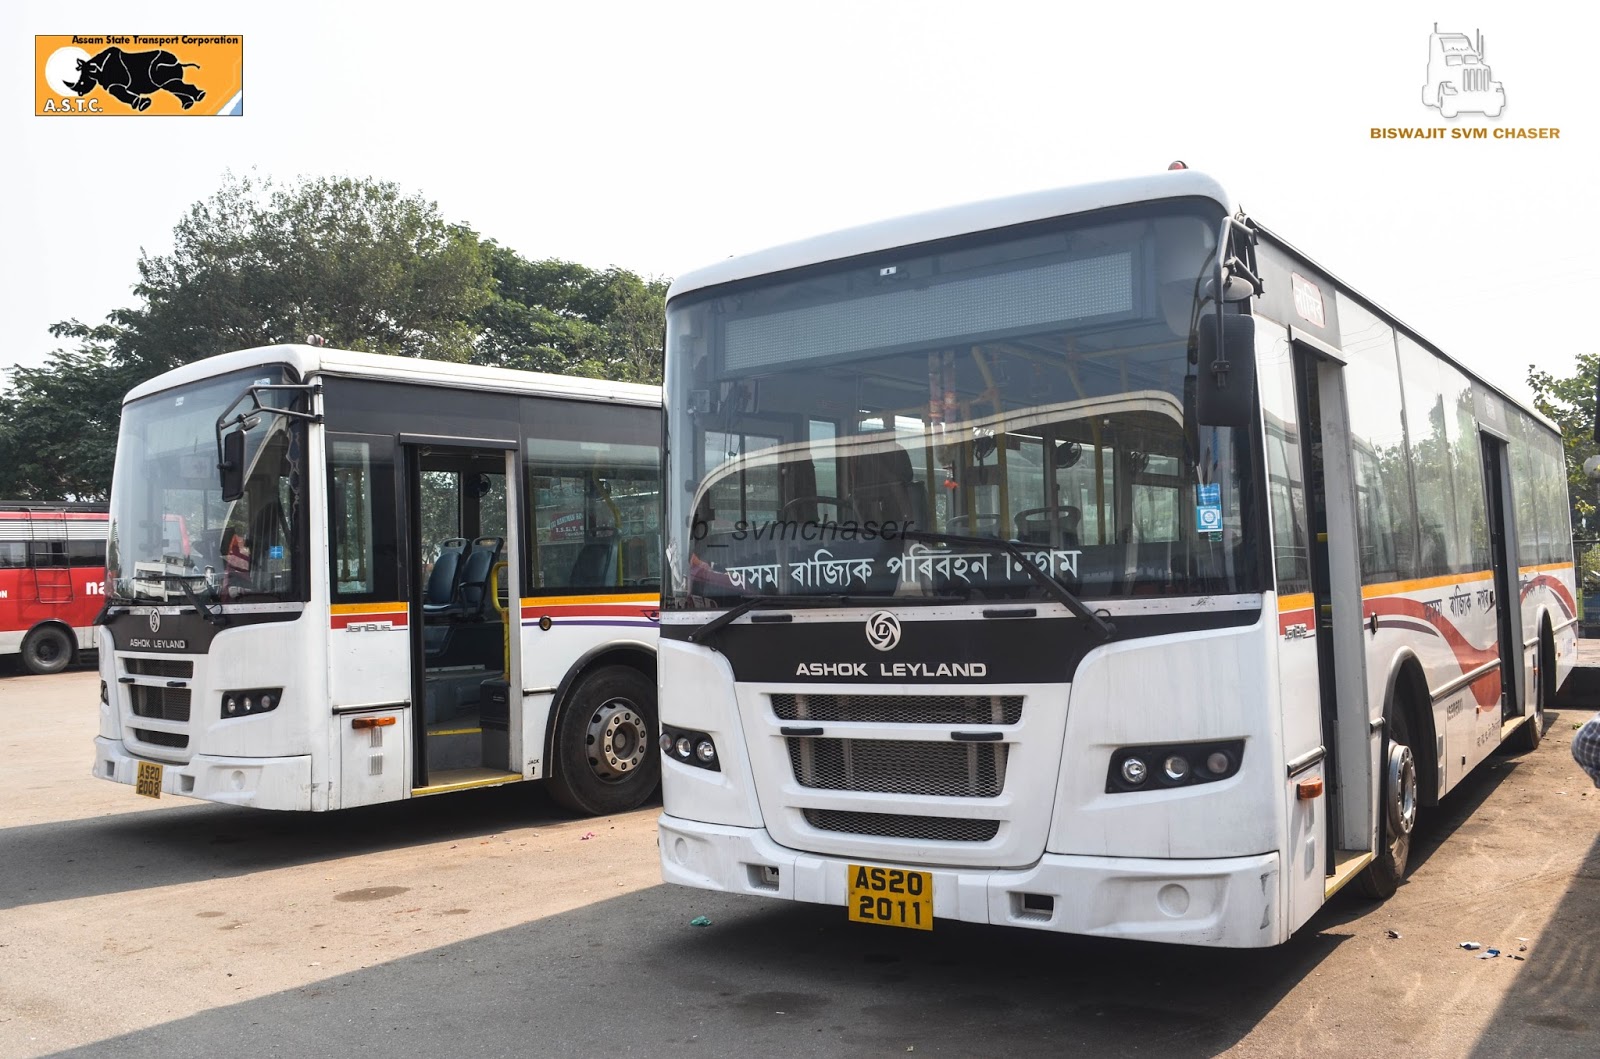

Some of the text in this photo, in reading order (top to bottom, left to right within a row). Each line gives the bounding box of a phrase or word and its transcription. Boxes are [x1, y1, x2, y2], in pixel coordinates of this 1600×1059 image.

[725, 563, 781, 590] অসম
[130, 638, 186, 649] ASHOK LEYLAND
[796, 663, 987, 677] ASHOK LEYLAND
[140, 764, 160, 781] AS20
[855, 866, 923, 895] AS20
[859, 895, 920, 925] 2011
